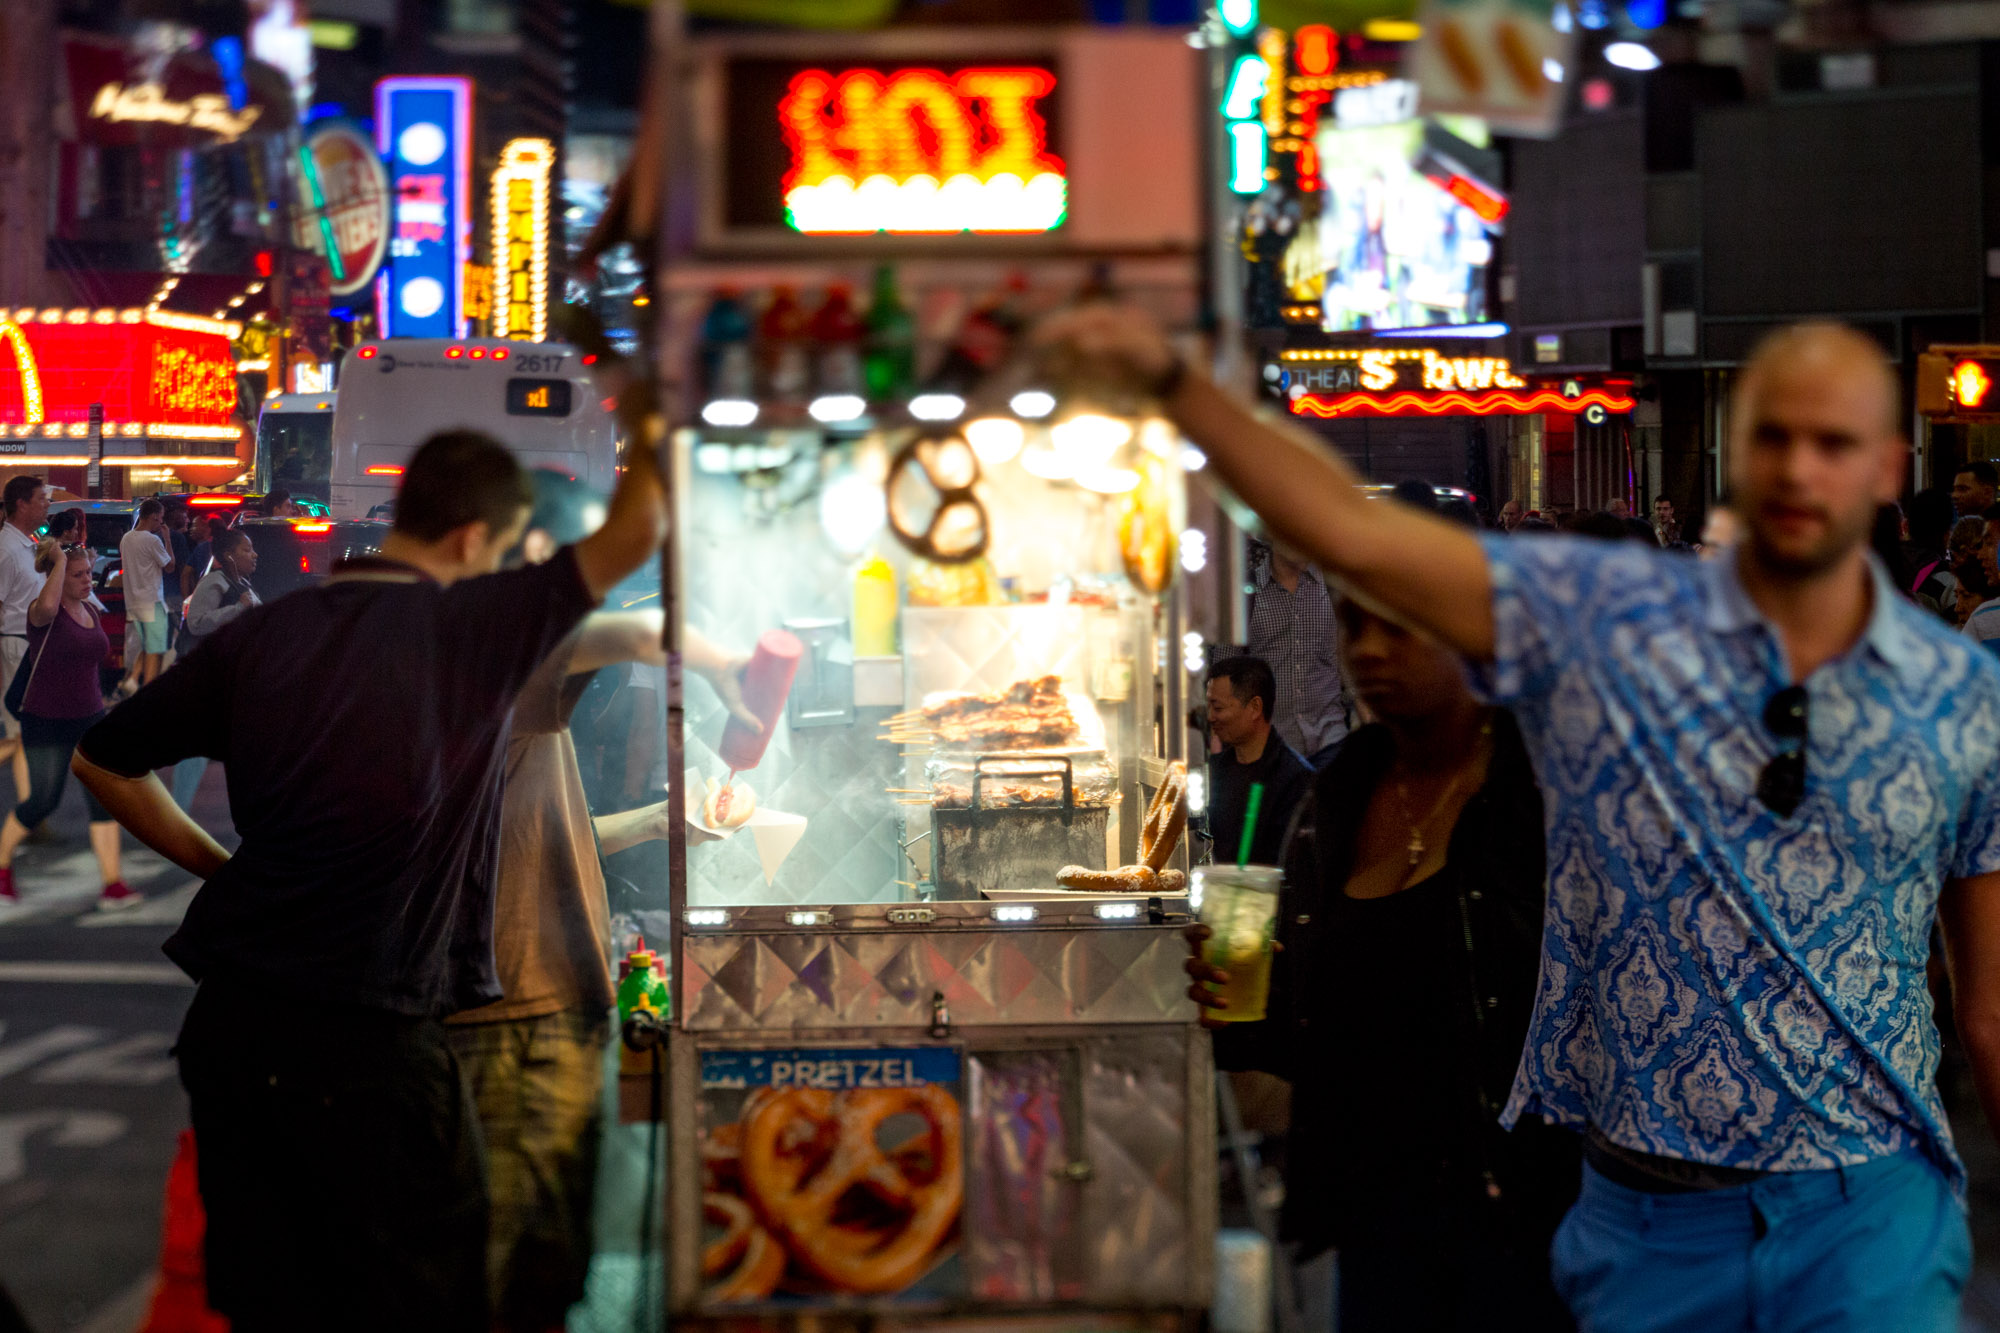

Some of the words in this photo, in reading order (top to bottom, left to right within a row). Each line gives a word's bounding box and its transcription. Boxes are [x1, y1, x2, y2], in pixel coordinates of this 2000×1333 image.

[515, 355, 564, 372] 2617
[1563, 380, 1581, 397] A
[1586, 405, 1605, 425] C
[770, 1058, 918, 1088] PRETZEL
